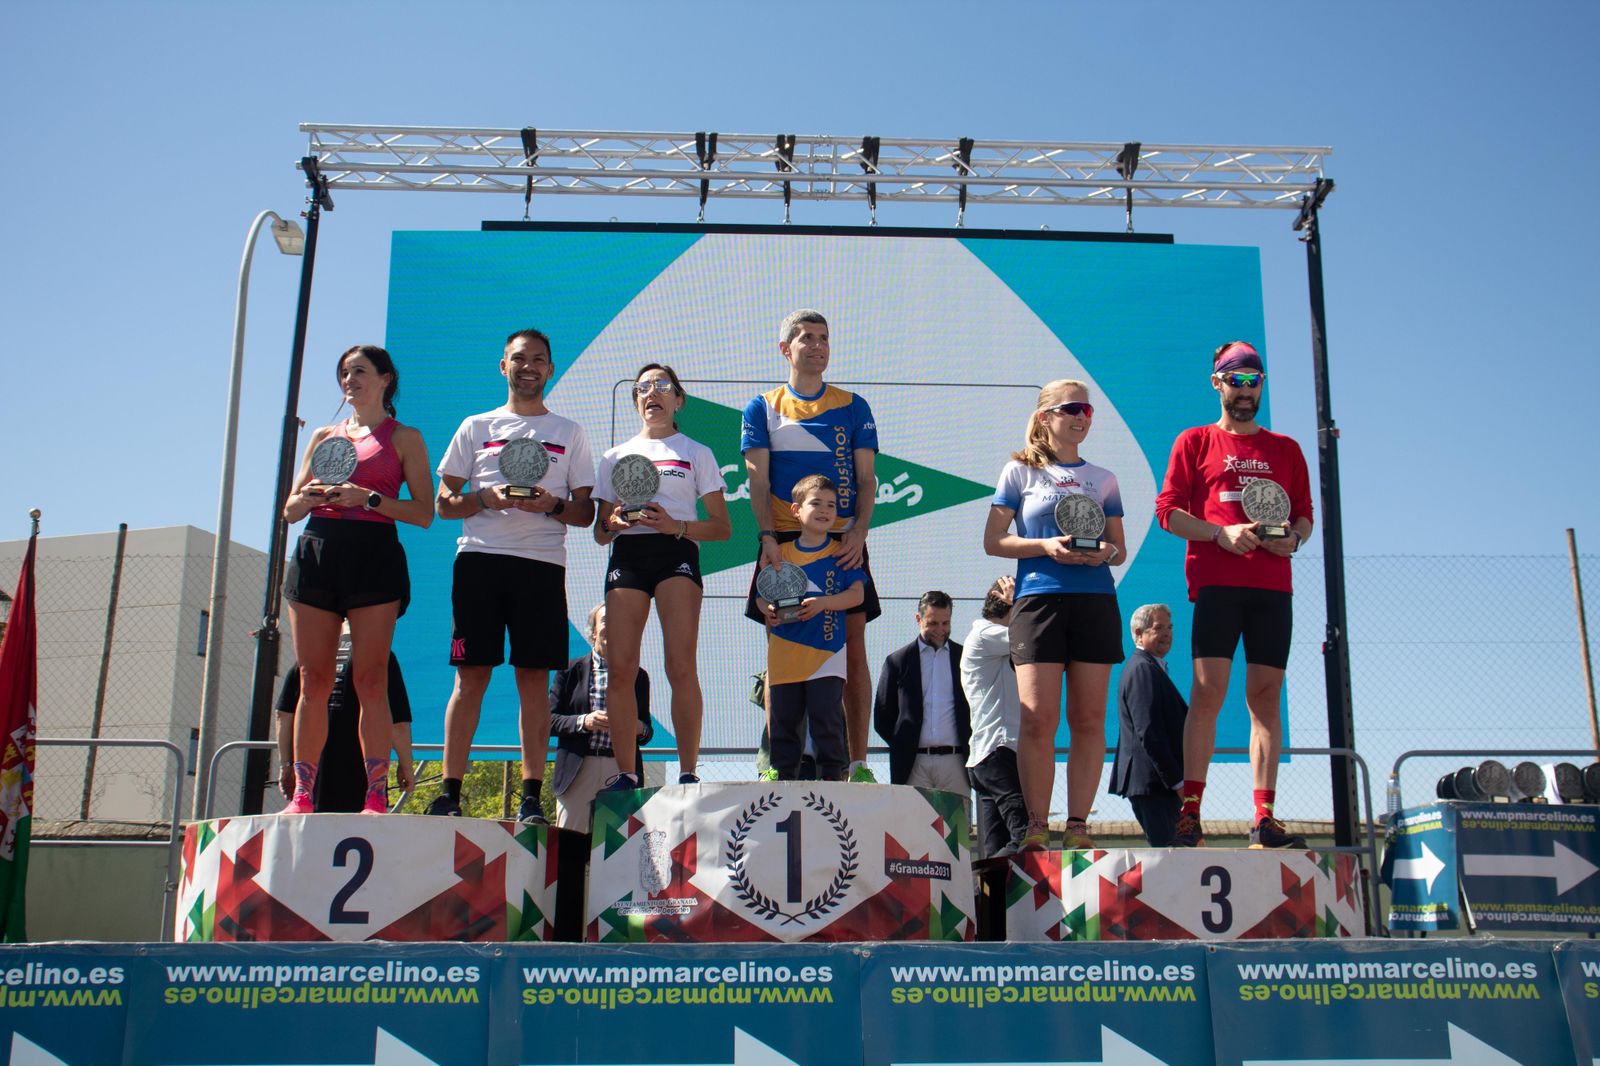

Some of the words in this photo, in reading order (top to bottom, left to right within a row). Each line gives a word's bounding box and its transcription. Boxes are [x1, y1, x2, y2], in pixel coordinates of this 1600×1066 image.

[510, 444, 536, 464] 18
[833, 425, 850, 509] agustinos
[1234, 459, 1270, 470] califas
[620, 460, 645, 480] 18
[1254, 485, 1279, 505] 18
[1066, 499, 1091, 519] 18
[1461, 811, 1595, 823] www.mpmarcelino.es
[1462, 820, 1596, 832] www.mpmarcelino.es
[776, 810, 802, 903] 1
[328, 836, 374, 924] 2
[890, 862, 950, 878] #Granada2031
[1200, 865, 1233, 934] 3
[166, 961, 480, 987] www.mpmarcelino.es
[523, 962, 833, 987] www.mpmarcelino.es
[890, 960, 1195, 986] www.mpmarcelino.es
[1237, 957, 1538, 983] www.mpmarcelino.es
[164, 983, 480, 1009] www.mpmarcelino.es
[521, 983, 834, 1009] www.mpmarcelino.es
[890, 982, 1197, 1008] www.mpmarcelino.es
[1239, 978, 1540, 1005] www.mpmarcelino.es
